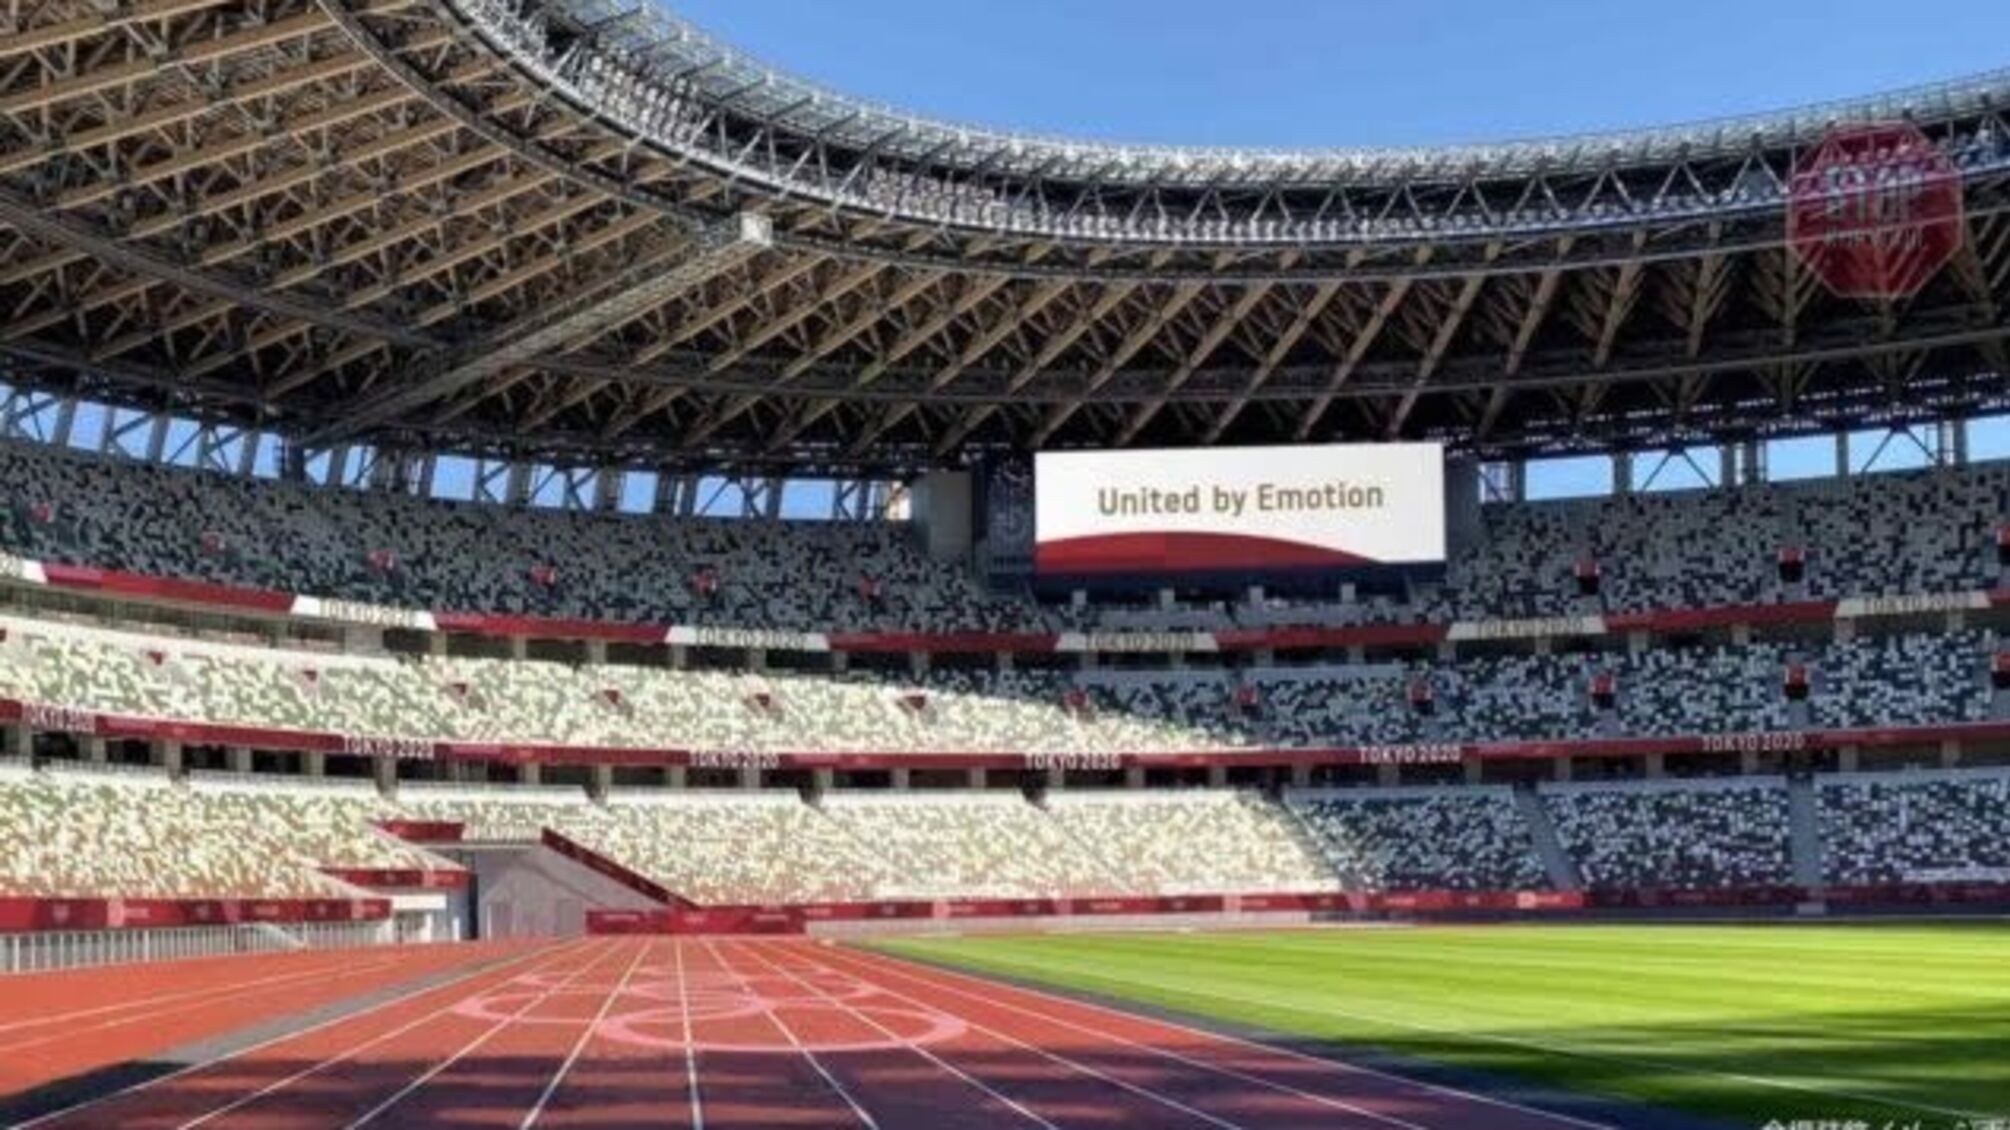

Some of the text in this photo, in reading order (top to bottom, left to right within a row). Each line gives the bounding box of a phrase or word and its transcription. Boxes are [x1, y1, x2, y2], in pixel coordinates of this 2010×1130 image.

[1099, 482, 1383, 517] United by Emotion
[345, 736, 433, 758] TOKYO 2020
[1702, 735, 1805, 752] TOKYO 2020
[691, 751, 779, 769] TOKYO 2020
[1025, 753, 1121, 770] TOKYO 2020
[1359, 746, 1461, 764] TOKYO 2020
